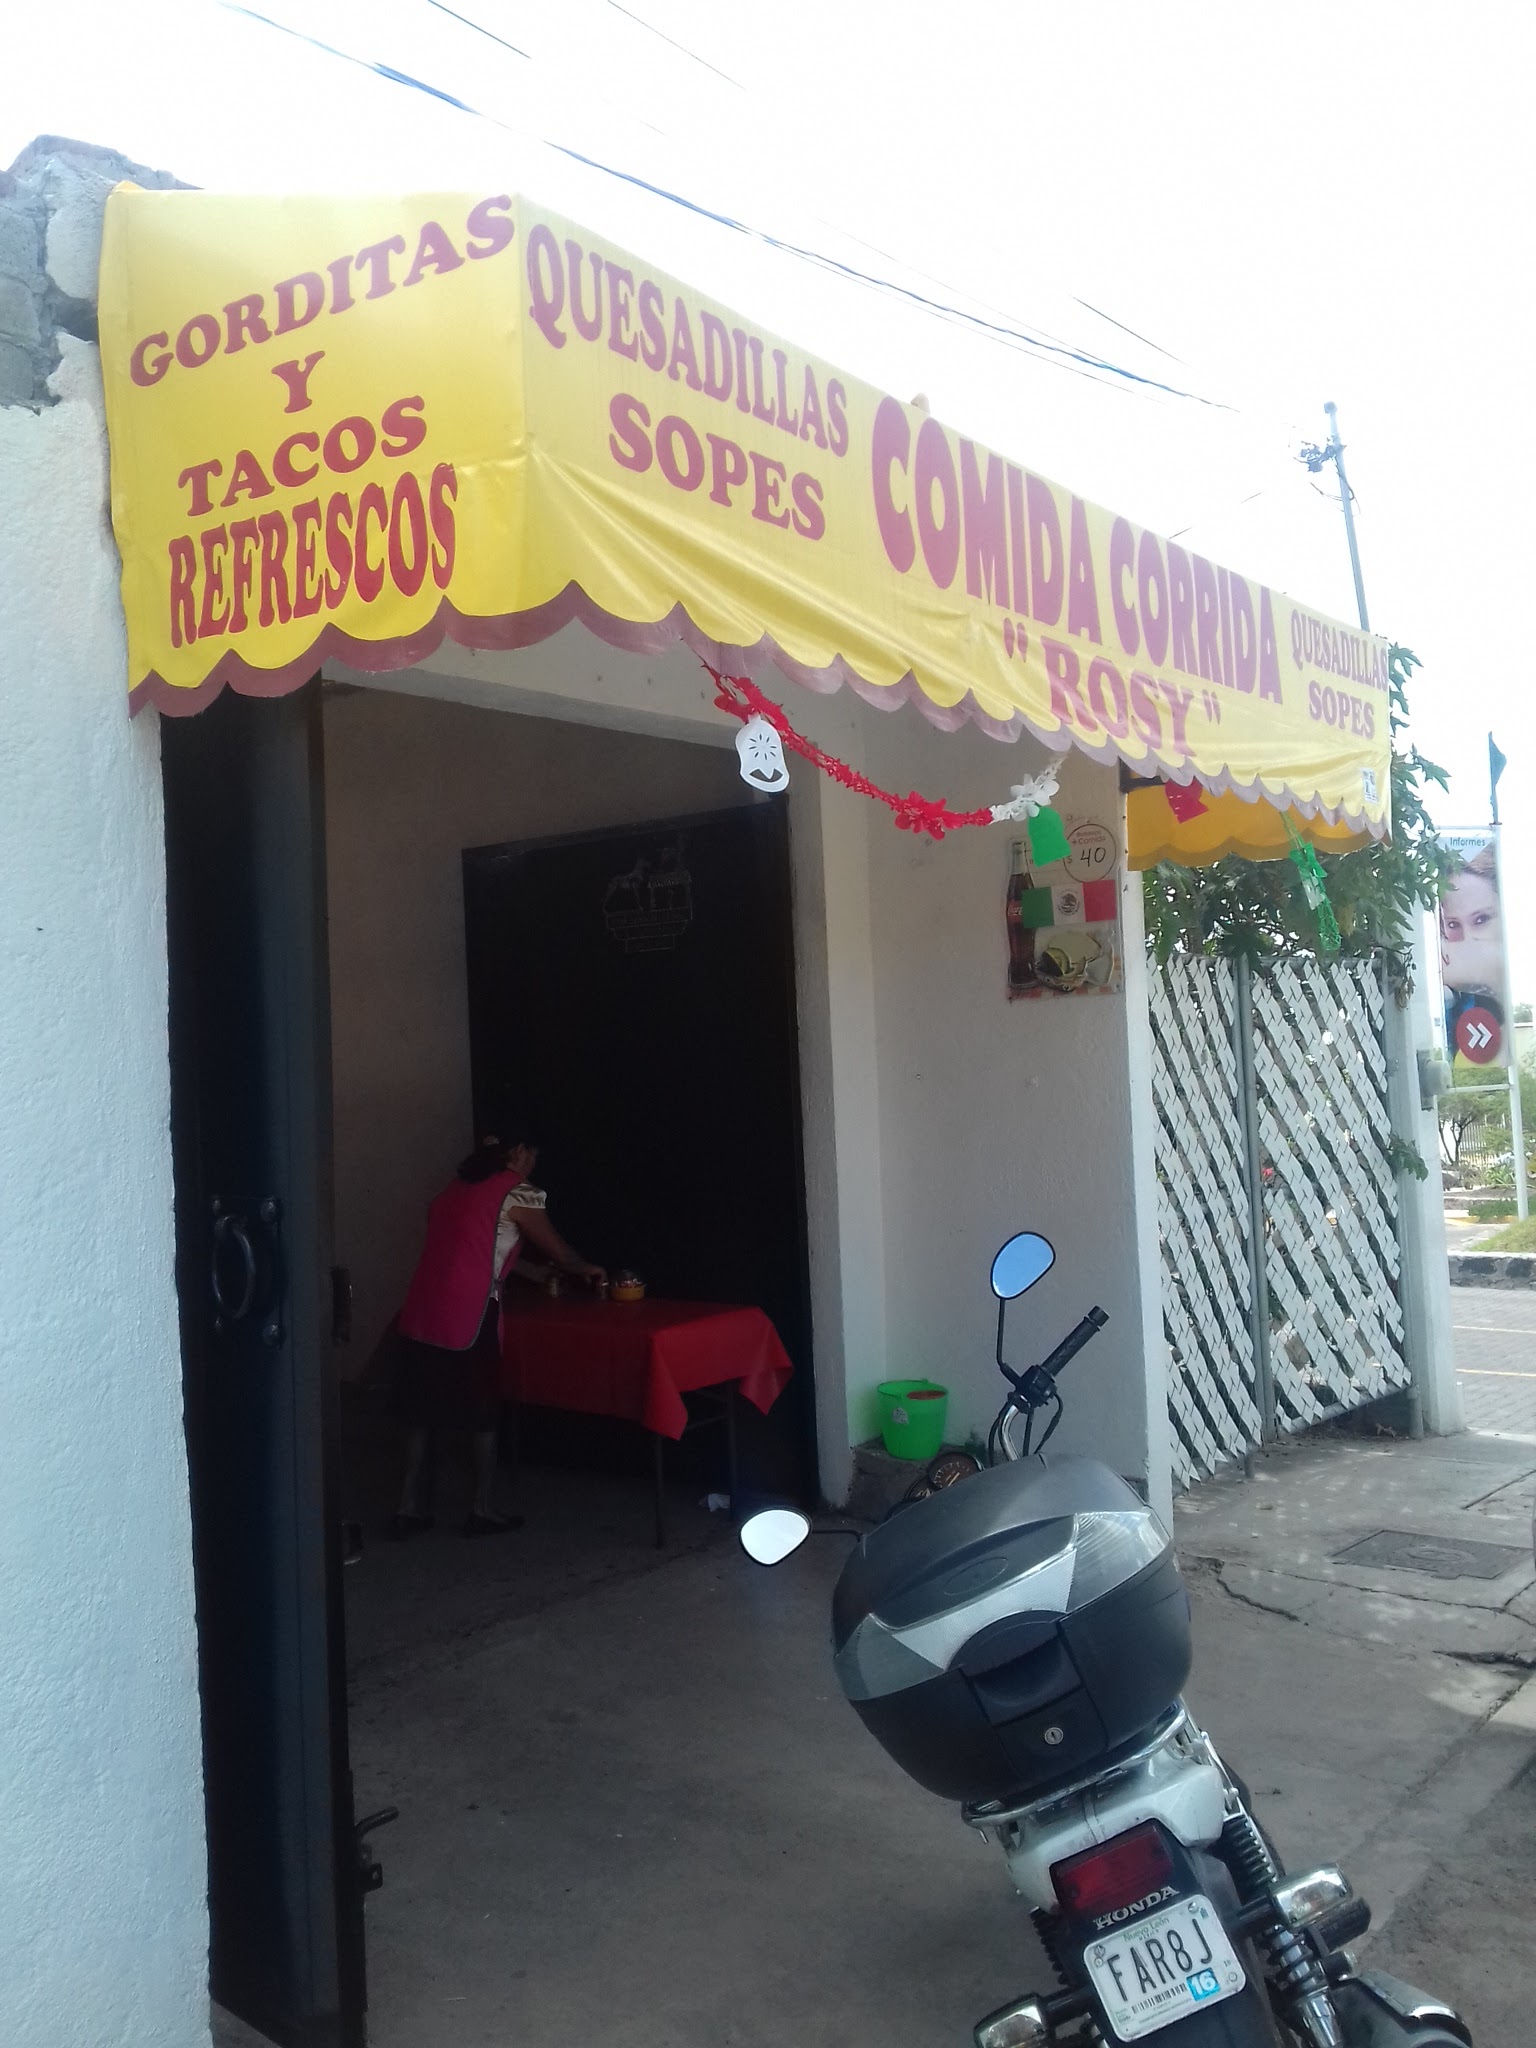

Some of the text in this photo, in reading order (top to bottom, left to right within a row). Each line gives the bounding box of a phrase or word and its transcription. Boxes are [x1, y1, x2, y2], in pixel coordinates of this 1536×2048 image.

[130, 195, 515, 388] GORDITAS
[271, 350, 326, 413] Y
[527, 223, 849, 457] QUESADILLAS
[177, 395, 427, 517] TACOS
[609, 393, 826, 541] SOPES
[168, 462, 458, 649] REFRESCOS
[871, 396, 1283, 705] COMIDA CORRIDA
[1291, 609, 1388, 692] QUESADILLAS
[1308, 680, 1375, 740] SOPES
[1080, 847, 1106, 868] 40
[1450, 836, 1486, 847] Informes
[1093, 1885, 1180, 1931] HONDA
[1106, 1918, 1213, 2002] FAR8J
[1191, 1972, 1216, 1997] 16
